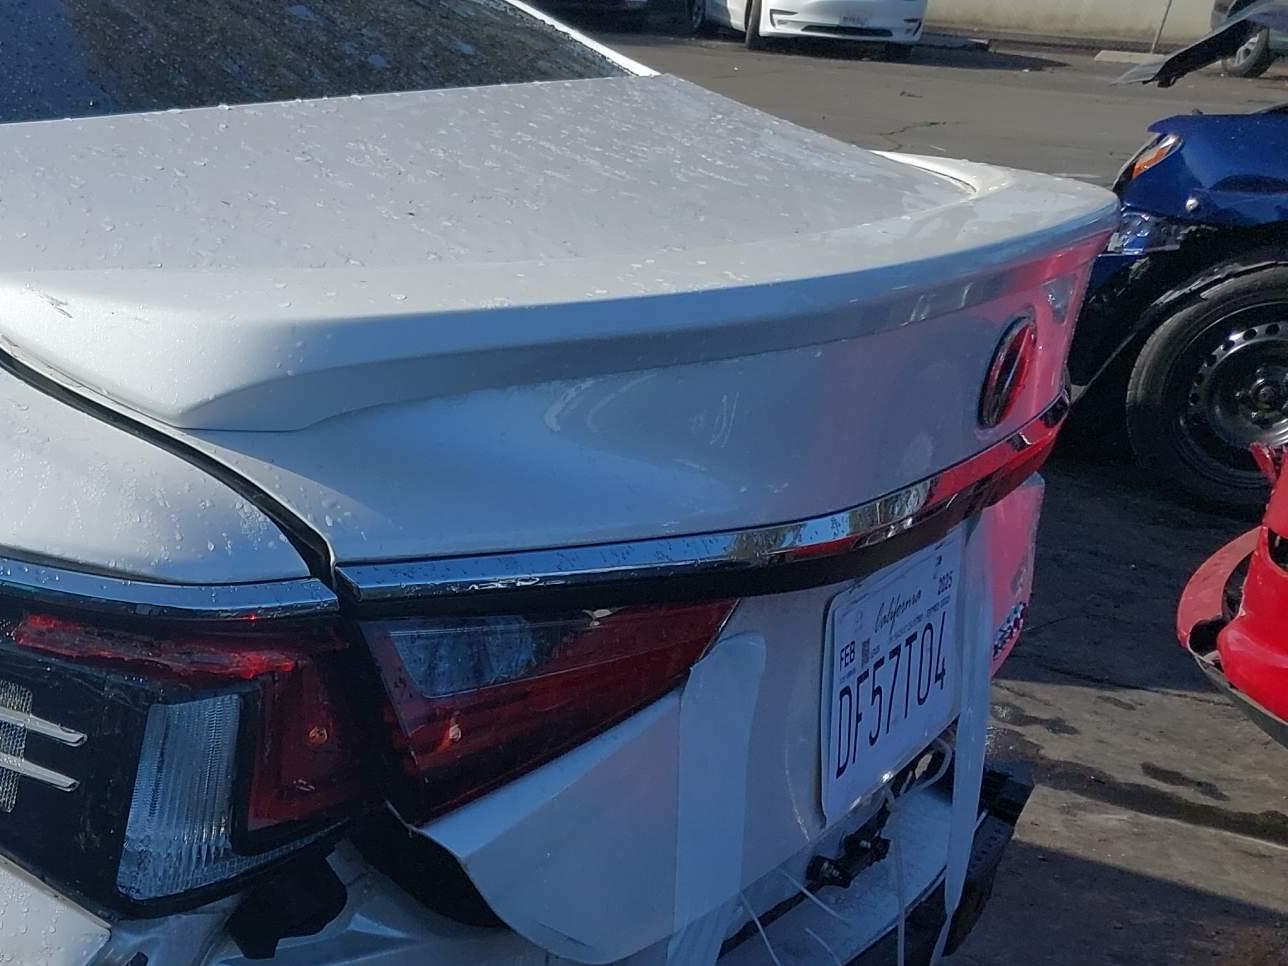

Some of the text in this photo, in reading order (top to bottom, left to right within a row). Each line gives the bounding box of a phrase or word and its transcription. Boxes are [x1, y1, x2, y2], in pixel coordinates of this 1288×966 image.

[874, 589, 922, 635] California
[839, 639, 856, 672] FEB
[835, 610, 946, 780] DF57T04
